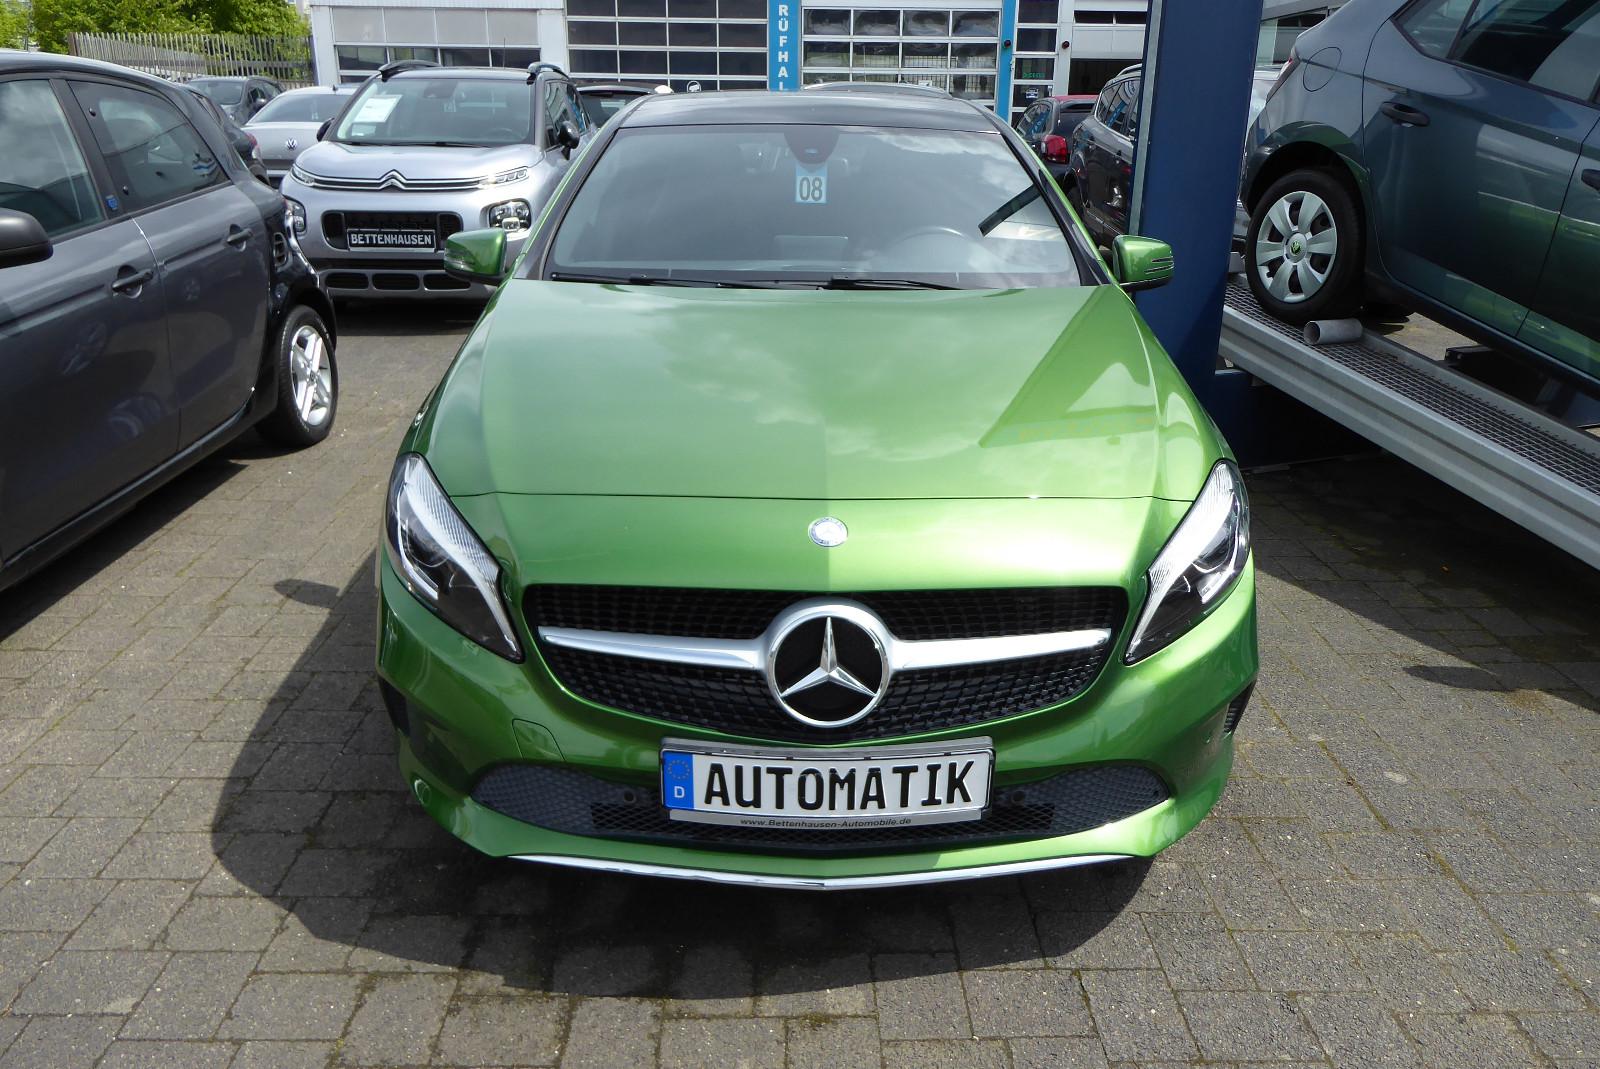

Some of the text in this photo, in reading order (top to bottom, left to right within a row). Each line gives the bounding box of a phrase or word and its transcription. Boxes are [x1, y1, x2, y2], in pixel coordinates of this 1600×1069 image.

[799, 176, 823, 201] 08
[351, 234, 432, 245] BETTENHAUSEN
[674, 761, 975, 811] D AUTOMATIK
[740, 818, 911, 829] www.Bettenhausen-Automobile.de
